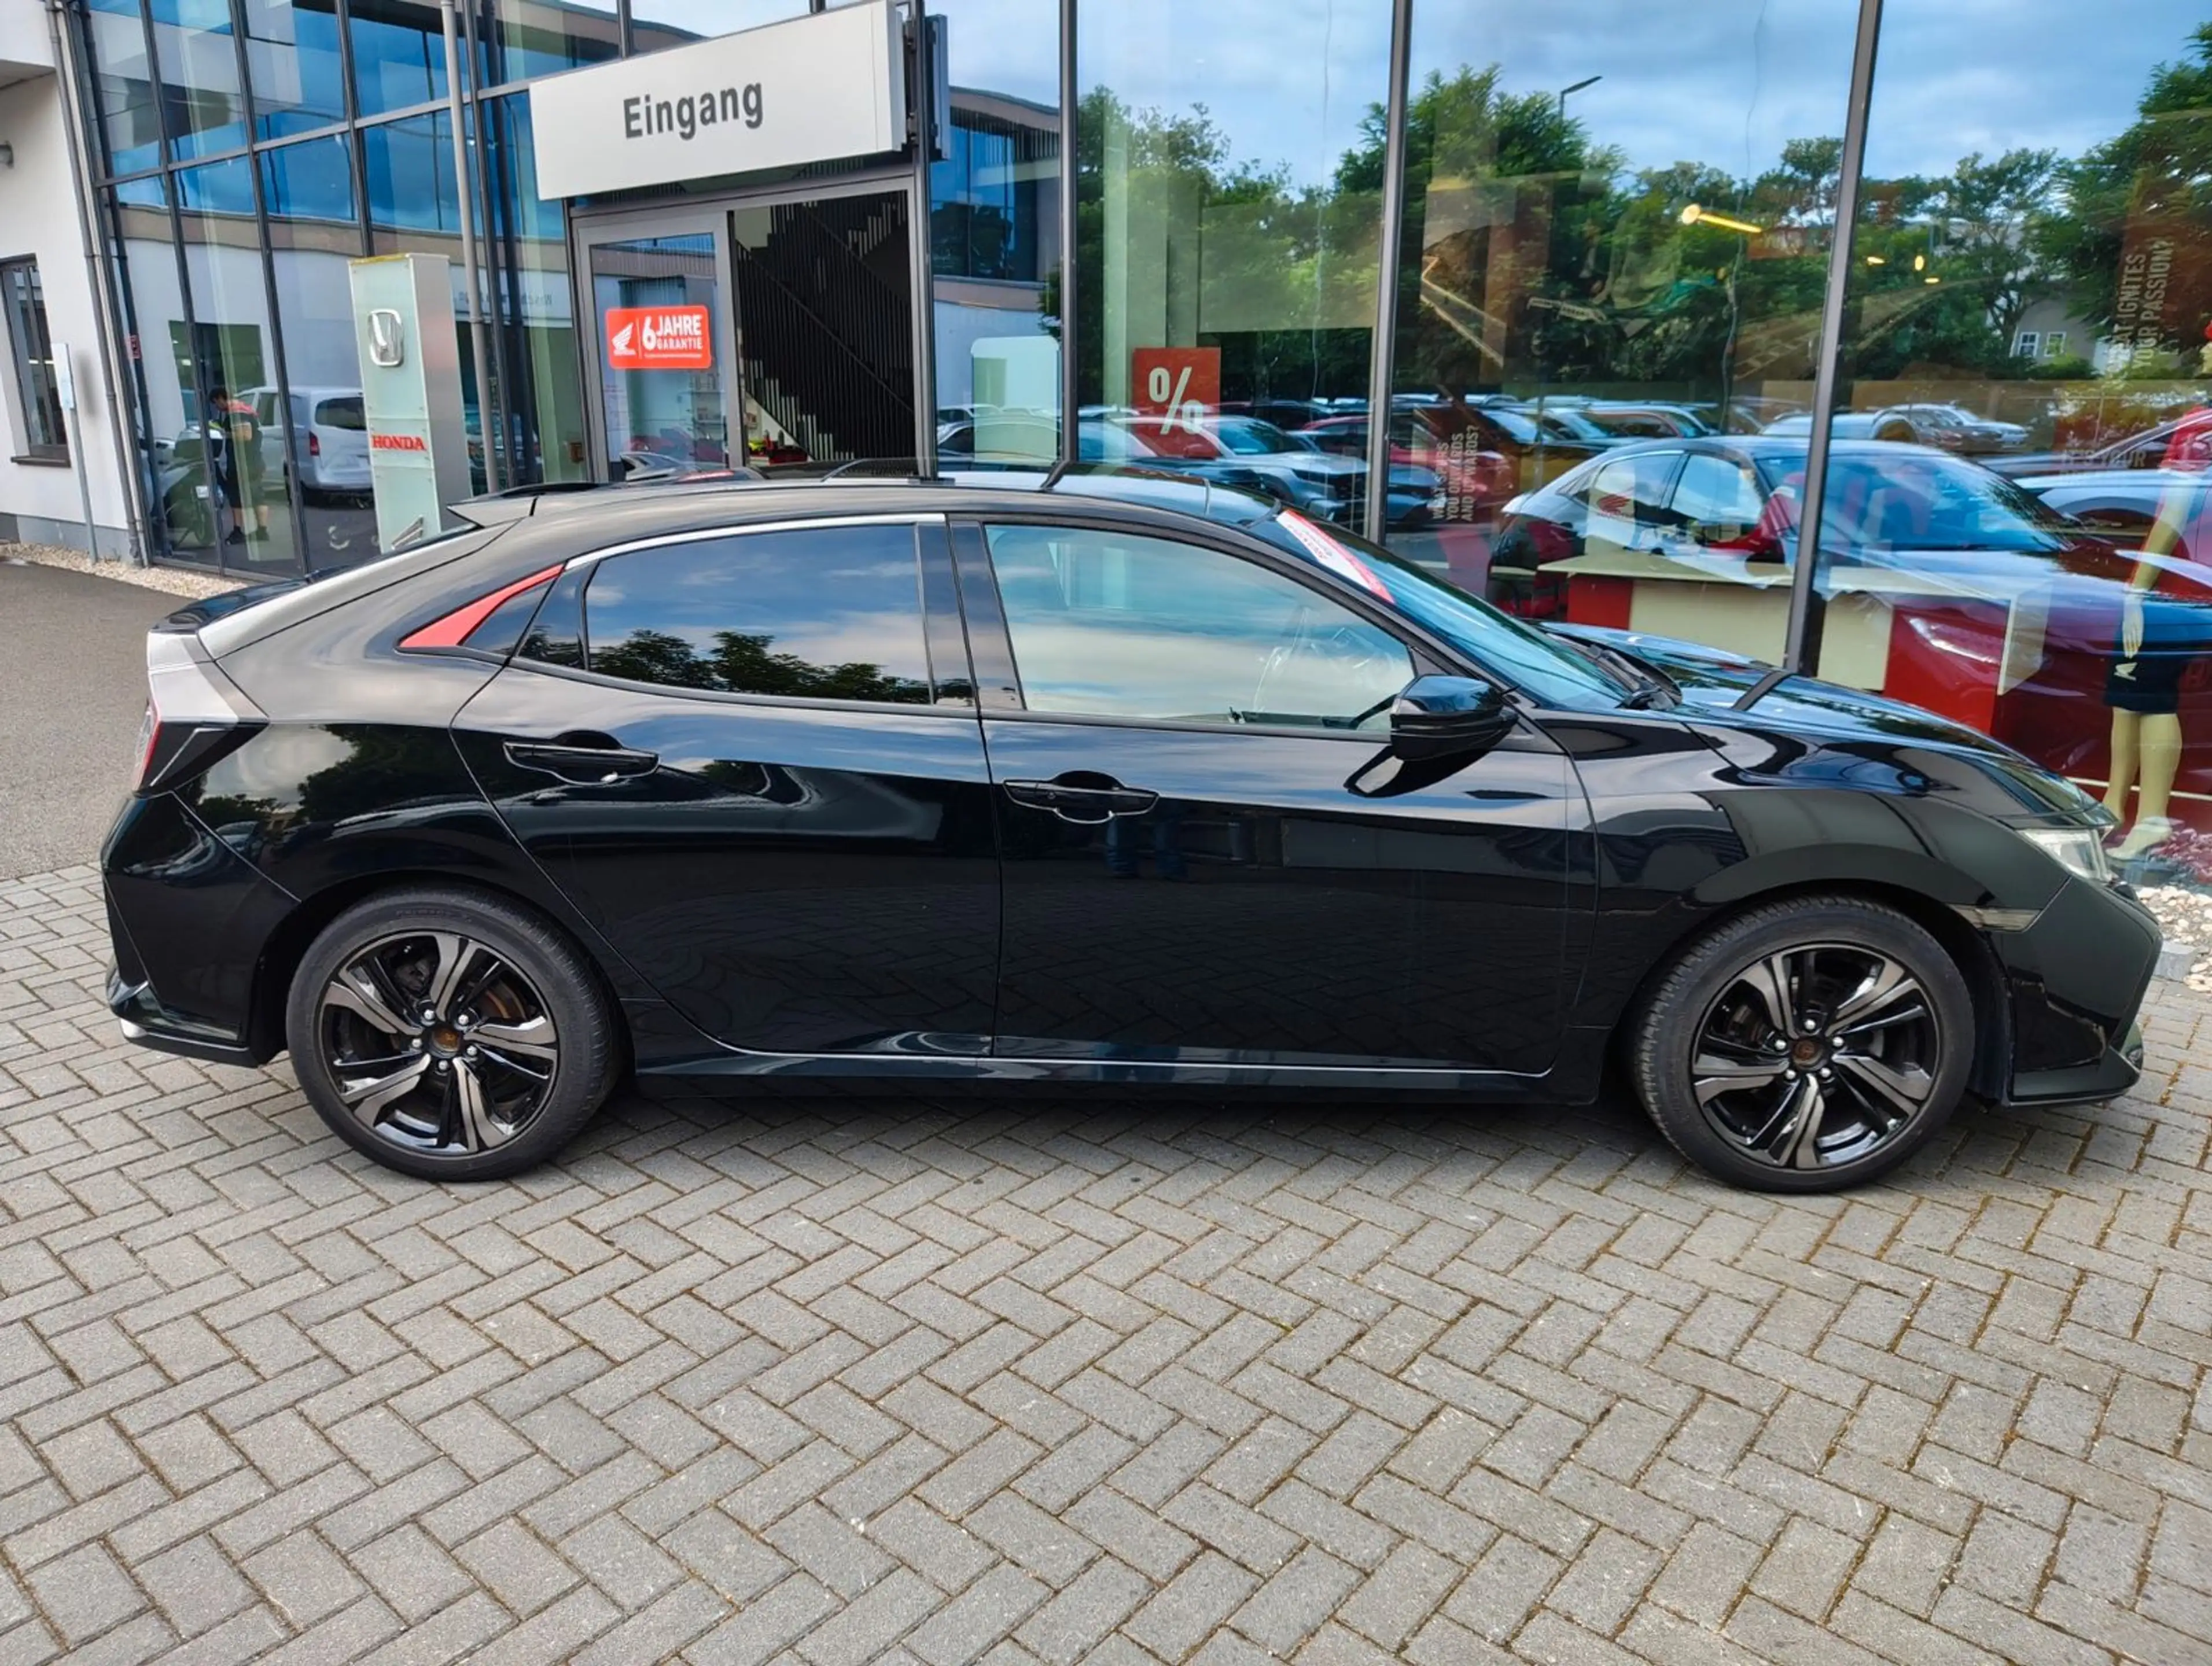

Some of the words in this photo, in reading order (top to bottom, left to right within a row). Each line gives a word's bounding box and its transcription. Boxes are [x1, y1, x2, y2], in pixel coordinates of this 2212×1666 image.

[623, 82, 763, 141] Eingang
[2116, 253, 2146, 318] IGNITES
[642, 315, 657, 351] 6
[656, 314, 702, 337] JAHRE
[656, 337, 703, 351] GARANTIE
[2132, 325, 2160, 369] YOUR
[1149, 366, 1204, 435] %
[372, 434, 426, 451] HONDA
[1447, 497, 1460, 521] YOU
[1461, 496, 1474, 521] AND
